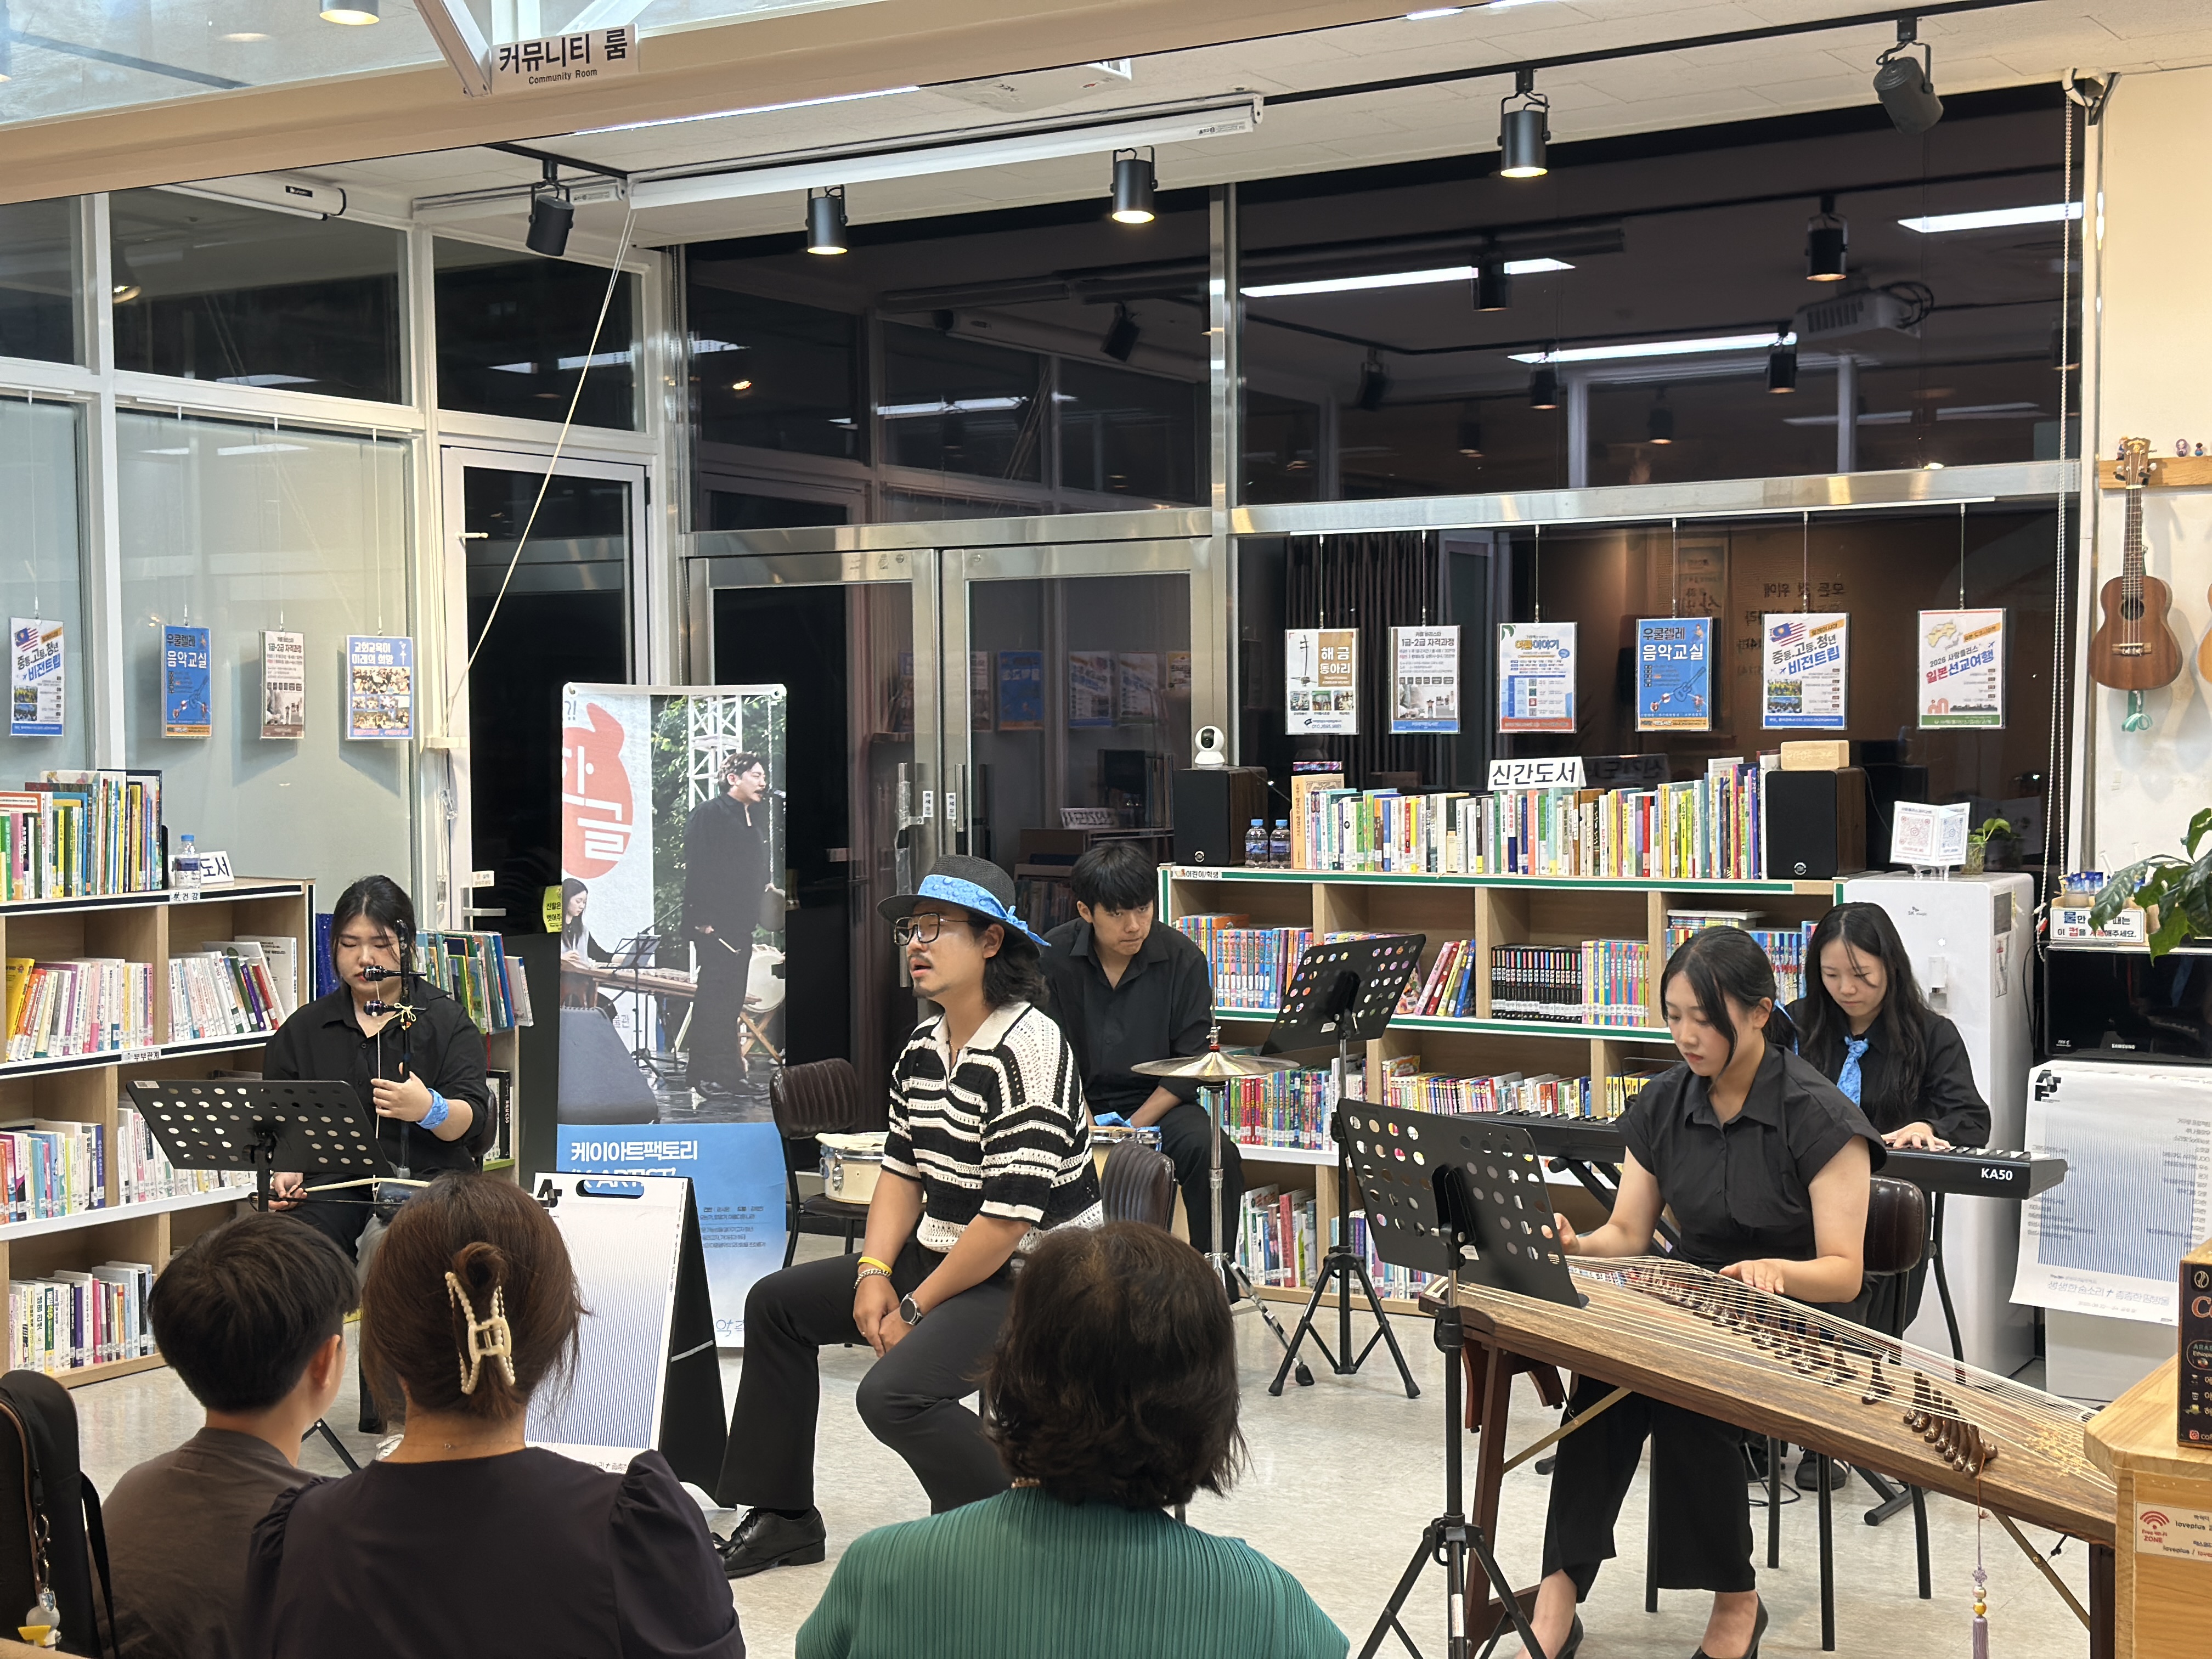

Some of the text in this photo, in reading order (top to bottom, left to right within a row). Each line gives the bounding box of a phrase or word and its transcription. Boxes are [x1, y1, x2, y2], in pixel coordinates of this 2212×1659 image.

[499, 29, 628, 74] 커뮤니티 룸
[528, 69, 597, 84] Community Room
[167, 634, 196, 647] 우쿨렐레
[1643, 627, 1685, 641] 우쿨렐레
[1402, 638, 1454, 646] 1급-2급 자격과정
[167, 650, 207, 669] 음악교실
[1642, 643, 1703, 662] 음악교실
[28, 653, 61, 681] 비전트립
[1788, 645, 1839, 675] 비전트립
[1319, 663, 1350, 674] 동아리
[1492, 761, 1576, 786] 신간도서
[1186, 870, 1218, 879] 어린이/학생
[183, 892, 198, 901] 건강
[546, 901, 561, 911] 신발은
[2068, 927, 2086, 936] 컵을
[134, 1051, 159, 1062] 부부관계
[571, 1140, 698, 1162] 케이아트팩토리
[1980, 1167, 2013, 1181] KA50
[2175, 1521, 2205, 1530] loveplus
